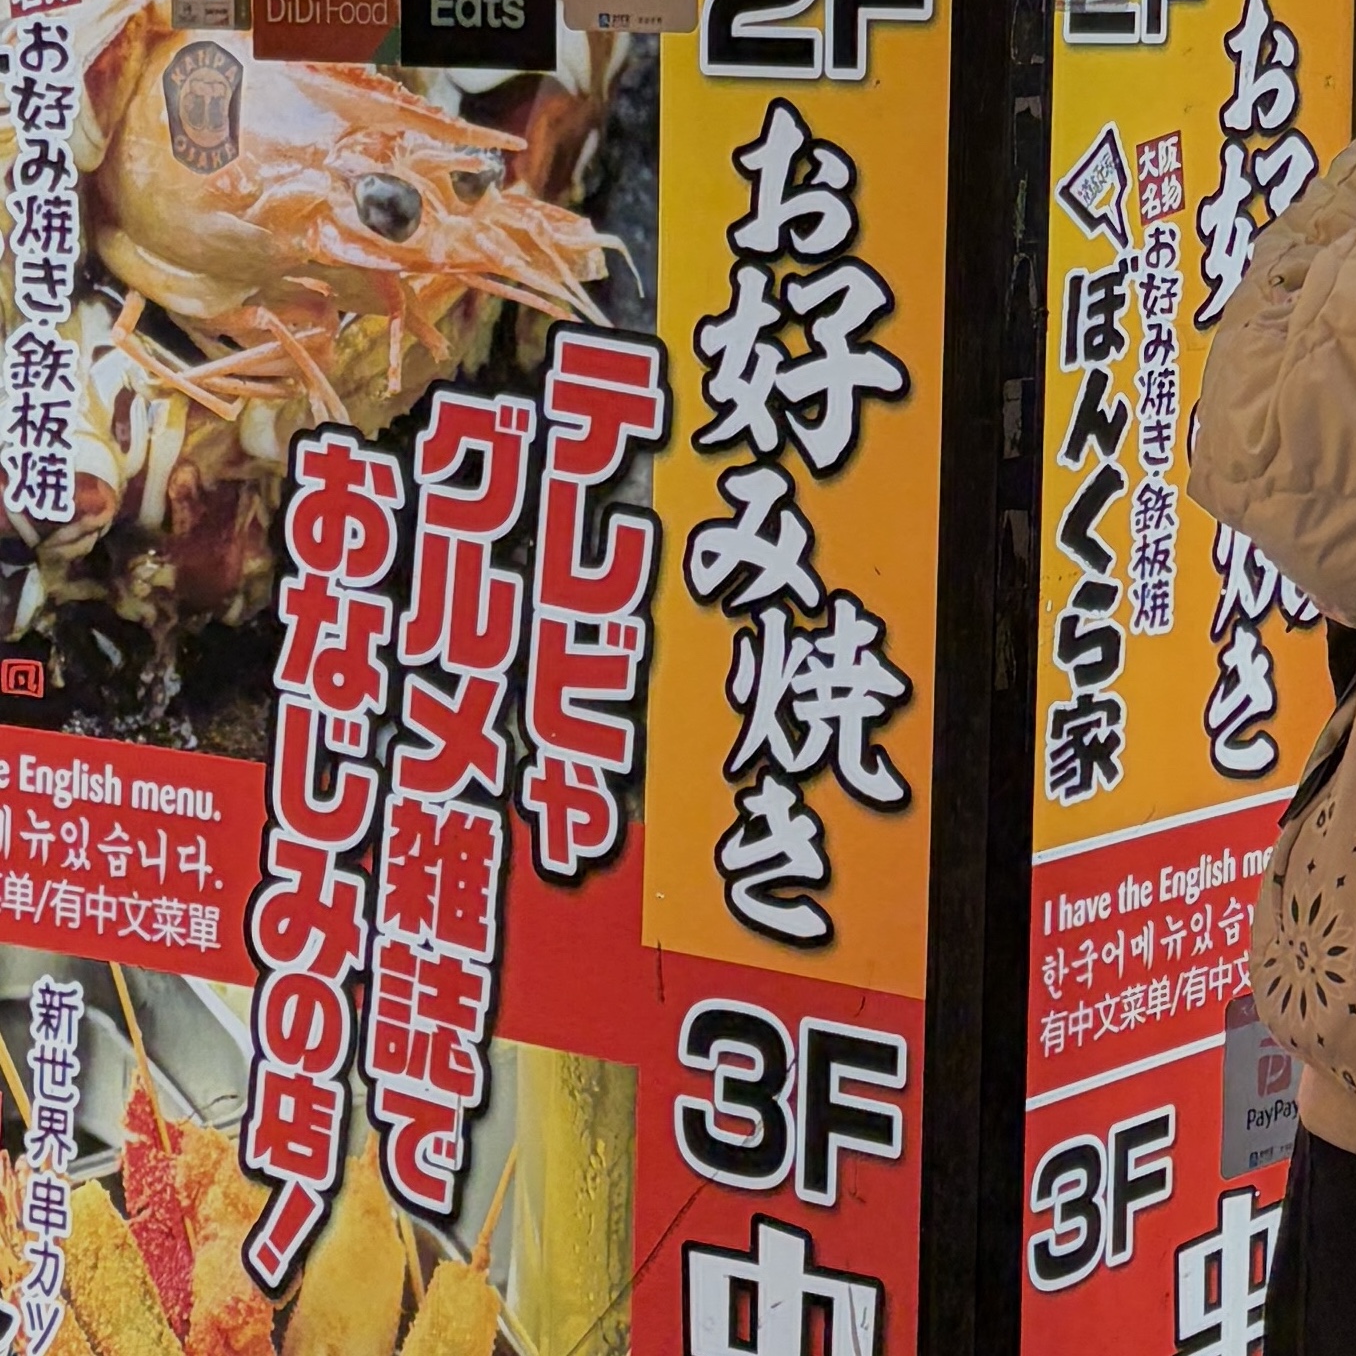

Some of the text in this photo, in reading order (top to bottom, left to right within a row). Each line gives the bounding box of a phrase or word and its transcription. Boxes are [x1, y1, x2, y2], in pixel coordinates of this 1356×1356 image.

[1138, 135, 1182, 181] 大阪
[1140, 174, 1183, 220] 名物
[11, 21, 76, 514] お好み焼き・鉄板焼
[684, 97, 911, 945] お好み焼き
[1132, 226, 1181, 630] お好み焼き・鉄板焼
[525, 330, 664, 874] テレビや
[1047, 254, 1140, 806] ぼんくら家
[19, 754, 122, 810] English
[131, 780, 222, 822] menu.
[366, 390, 536, 1214] グルメ雑誌で
[0, 870, 222, 953] 单/有中文菜單
[1041, 896, 1253, 1002] 한국어메뉴있습
[1043, 899, 1053, 936] I
[1058, 894, 1112, 931] have
[1117, 874, 1154, 914] the
[1159, 847, 1238, 905] English
[26, 982, 80, 1356] 新世界 串カツ
[674, 999, 907, 1207] 3F
[1029, 1105, 1176, 1293] 3F
[1246, 1098, 1299, 1132] PayPay
